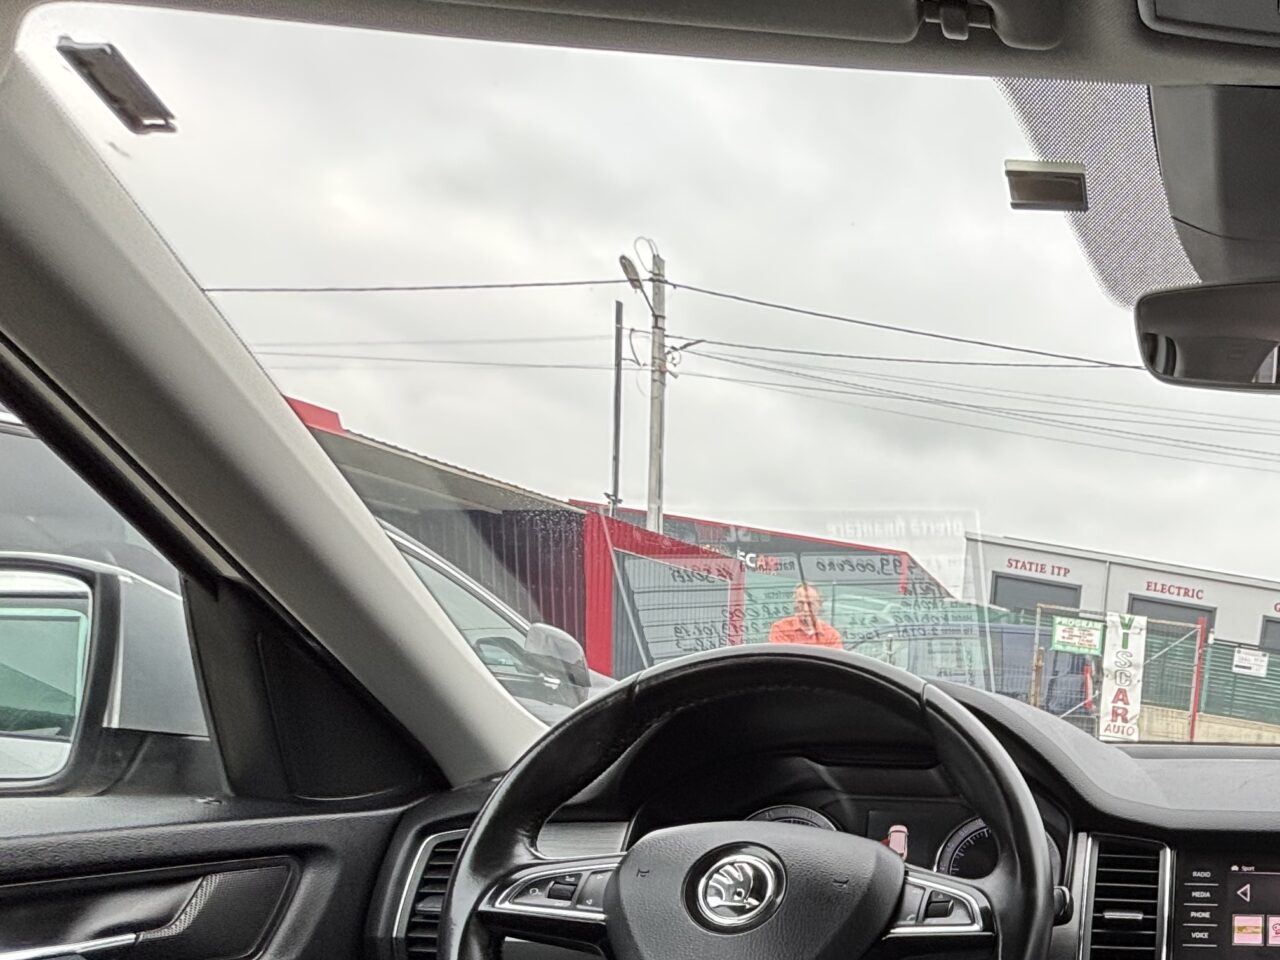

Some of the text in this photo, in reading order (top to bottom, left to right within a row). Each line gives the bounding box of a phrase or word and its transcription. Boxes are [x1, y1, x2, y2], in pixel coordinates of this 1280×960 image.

[1006, 558, 1071, 578] STATIE ITP
[1145, 581, 1204, 601] ELECTRIC
[1103, 723, 1135, 737] AUTO
